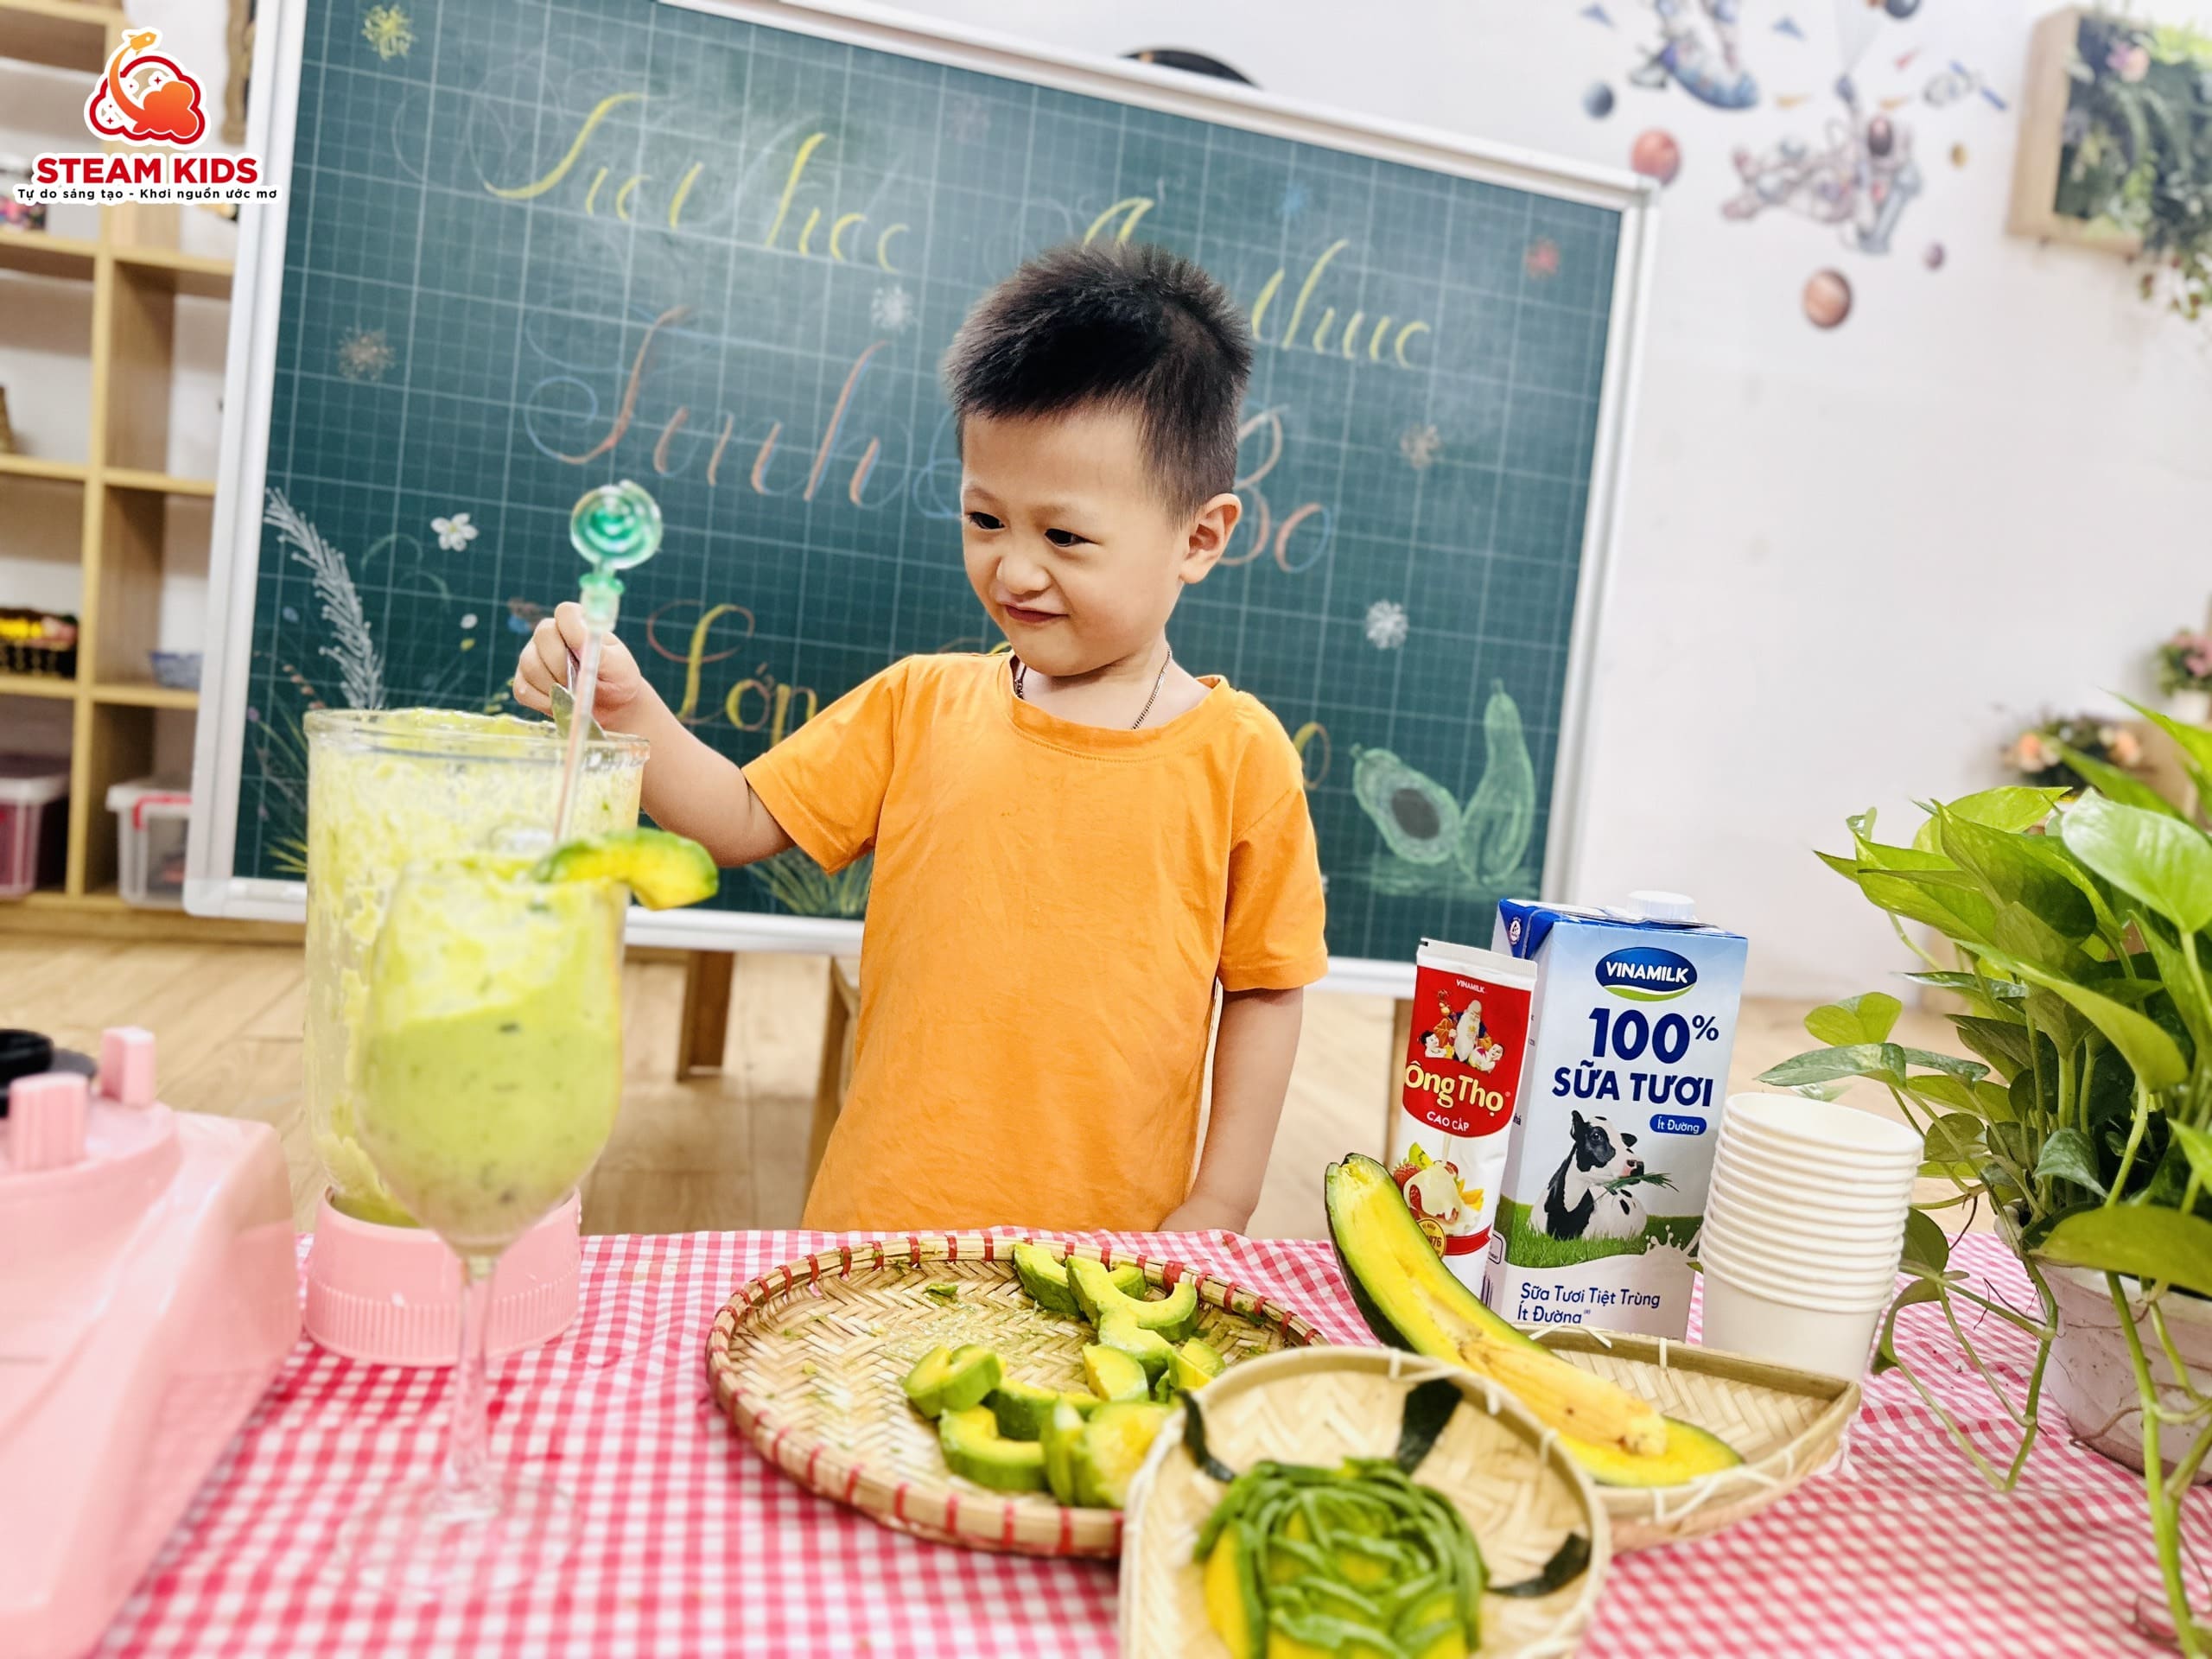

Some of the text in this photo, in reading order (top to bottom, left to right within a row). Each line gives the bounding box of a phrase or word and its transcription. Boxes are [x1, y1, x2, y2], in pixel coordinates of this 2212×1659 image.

[1605, 961, 1689, 983] VINAMILK
[1456, 979, 1485, 994] VINAMILK
[1588, 1007, 1719, 1065] 100%
[1405, 1059, 1504, 1116] Ông Thọ
[1552, 1059, 1713, 1107] SỮA TƯƠI
[1427, 1111, 1450, 1127] CAO
[1657, 1116, 1700, 1135] Ít Đường
[1521, 1282, 1661, 1309] Sữa Tươi Tiệt Trùng
[1517, 1300, 1529, 1320] Ít
